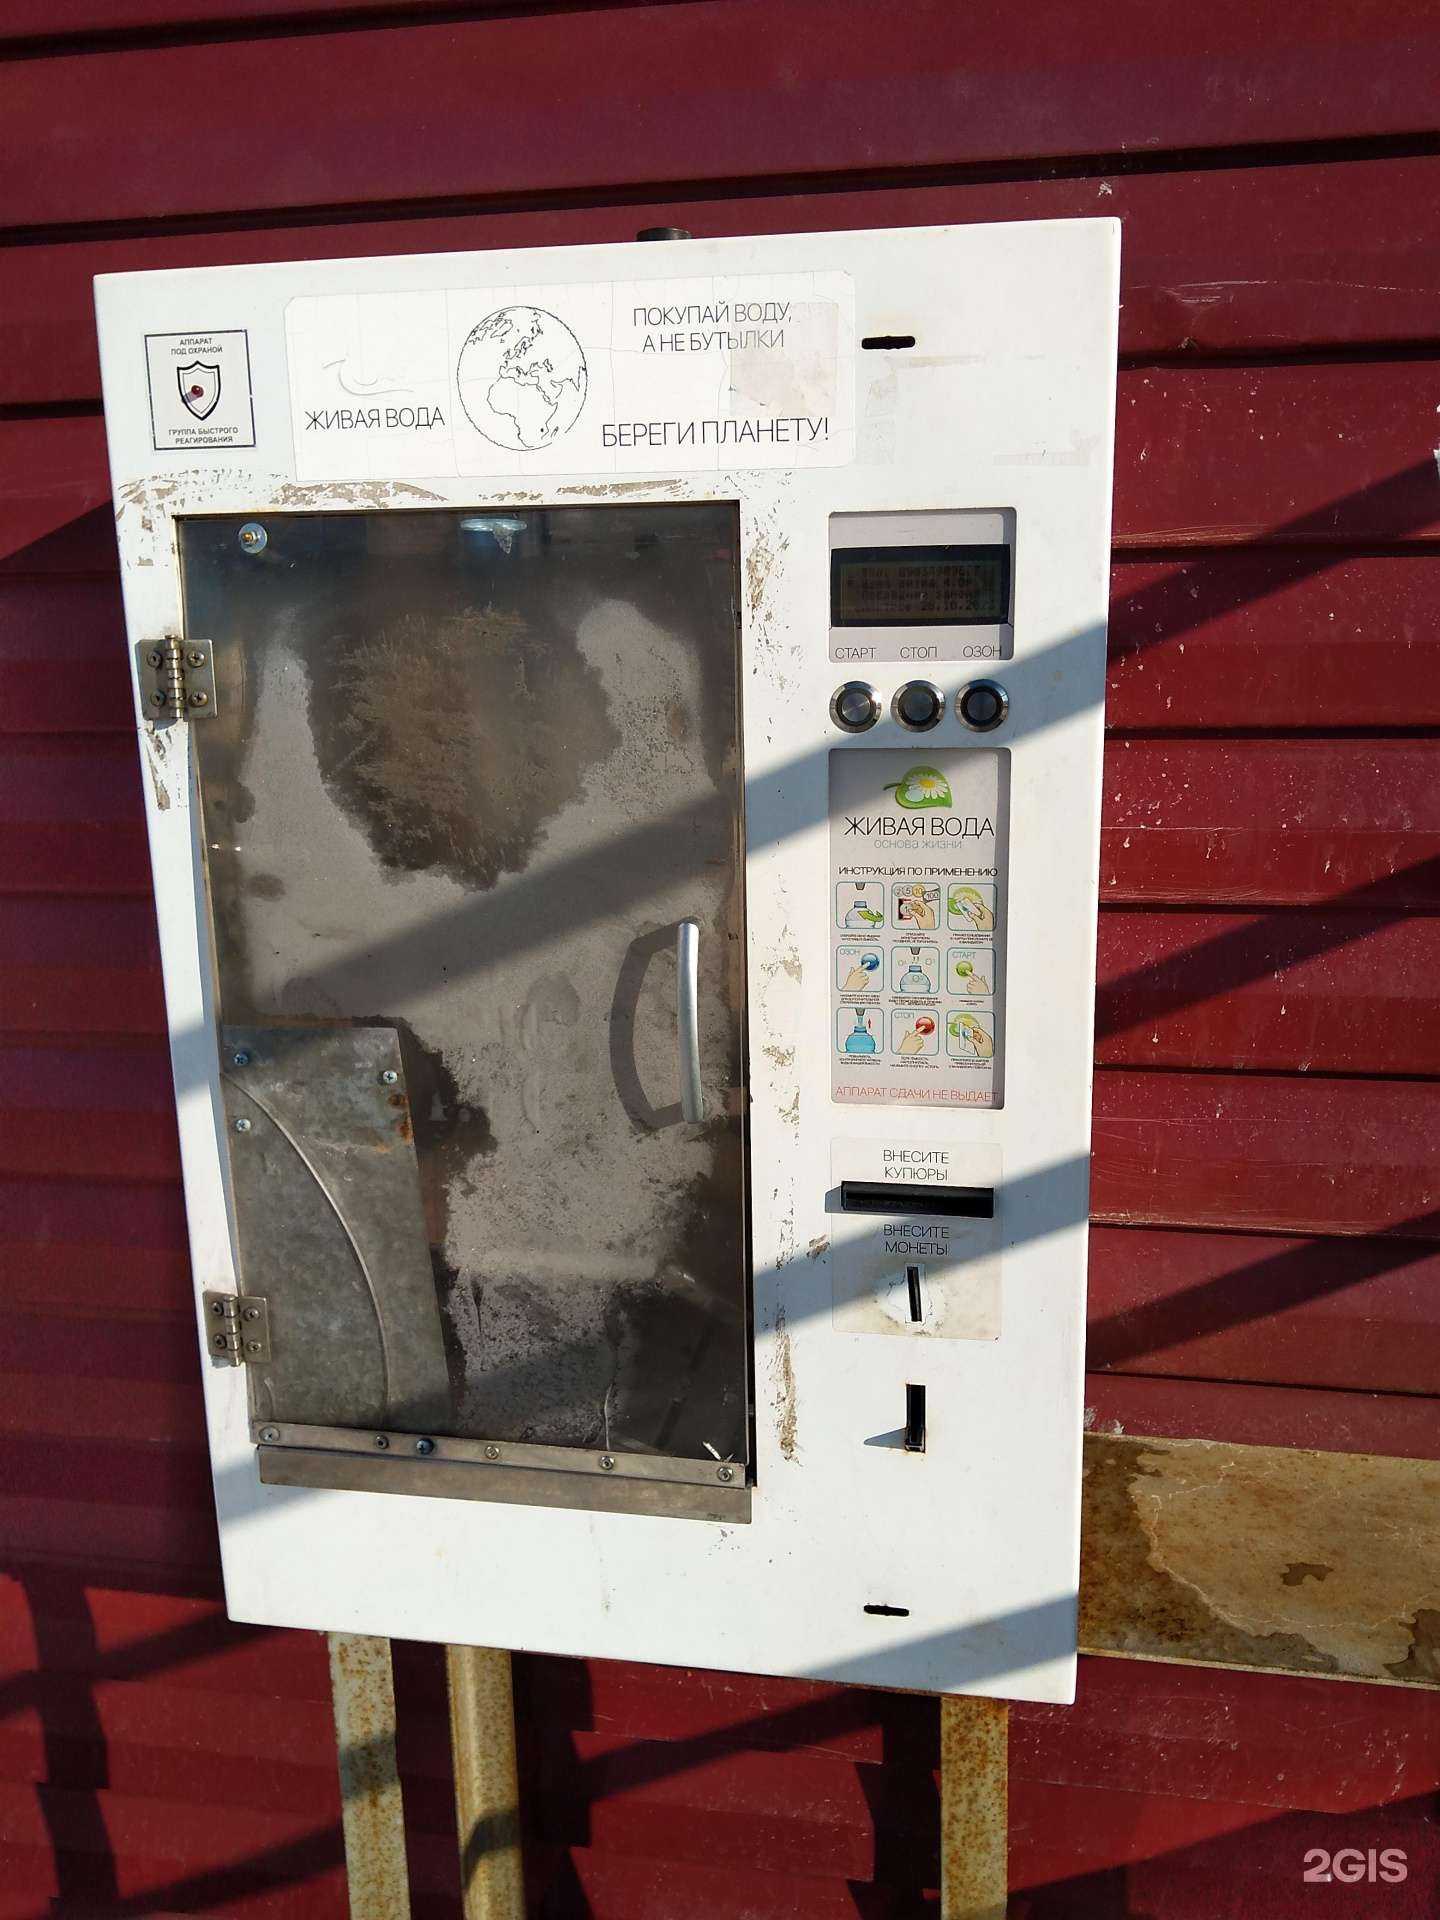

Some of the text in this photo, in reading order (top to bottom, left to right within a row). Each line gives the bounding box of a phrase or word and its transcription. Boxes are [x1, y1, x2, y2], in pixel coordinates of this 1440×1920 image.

[633, 300, 792, 327] ПОКУПАЙ ВОДУ,
[179, 337, 213, 346] АППАРАТ
[642, 329, 784, 352] А НЕ БУТЫЛКИ
[170, 345, 223, 356] ПОД ОХРАНОЙ
[304, 406, 446, 430] ЖИВАЯ ВОДА
[168, 426, 239, 436] ГРУППА БЫСТРОГО
[602, 417, 829, 447] БЕРЕГИ ПЛАНЕТУ!
[175, 435, 233, 445] РЕАГИРОВАНИЯ
[834, 647, 877, 659] СТАРТ
[899, 646, 938, 659] СТОП
[962, 645, 1003, 658] ОЗОН
[844, 816, 995, 839] ЖИВАЯ ВОДА
[838, 866, 999, 877] ИНСТРУКЦИЯ ПО ПРИМЕНЕНИЮ
[952, 951, 976, 960] СТАРТ
[836, 1086, 999, 1102] АППАРАТ СДАЧИ НЕ ВЫДАЕТ
[883, 1150, 949, 1164] ВНЕСИТЕ
[885, 1167, 947, 1180] КУПЮРЫ
[883, 1224, 949, 1238] ВНЕСИТЕ
[885, 1242, 947, 1255] МОНЕТЫ
